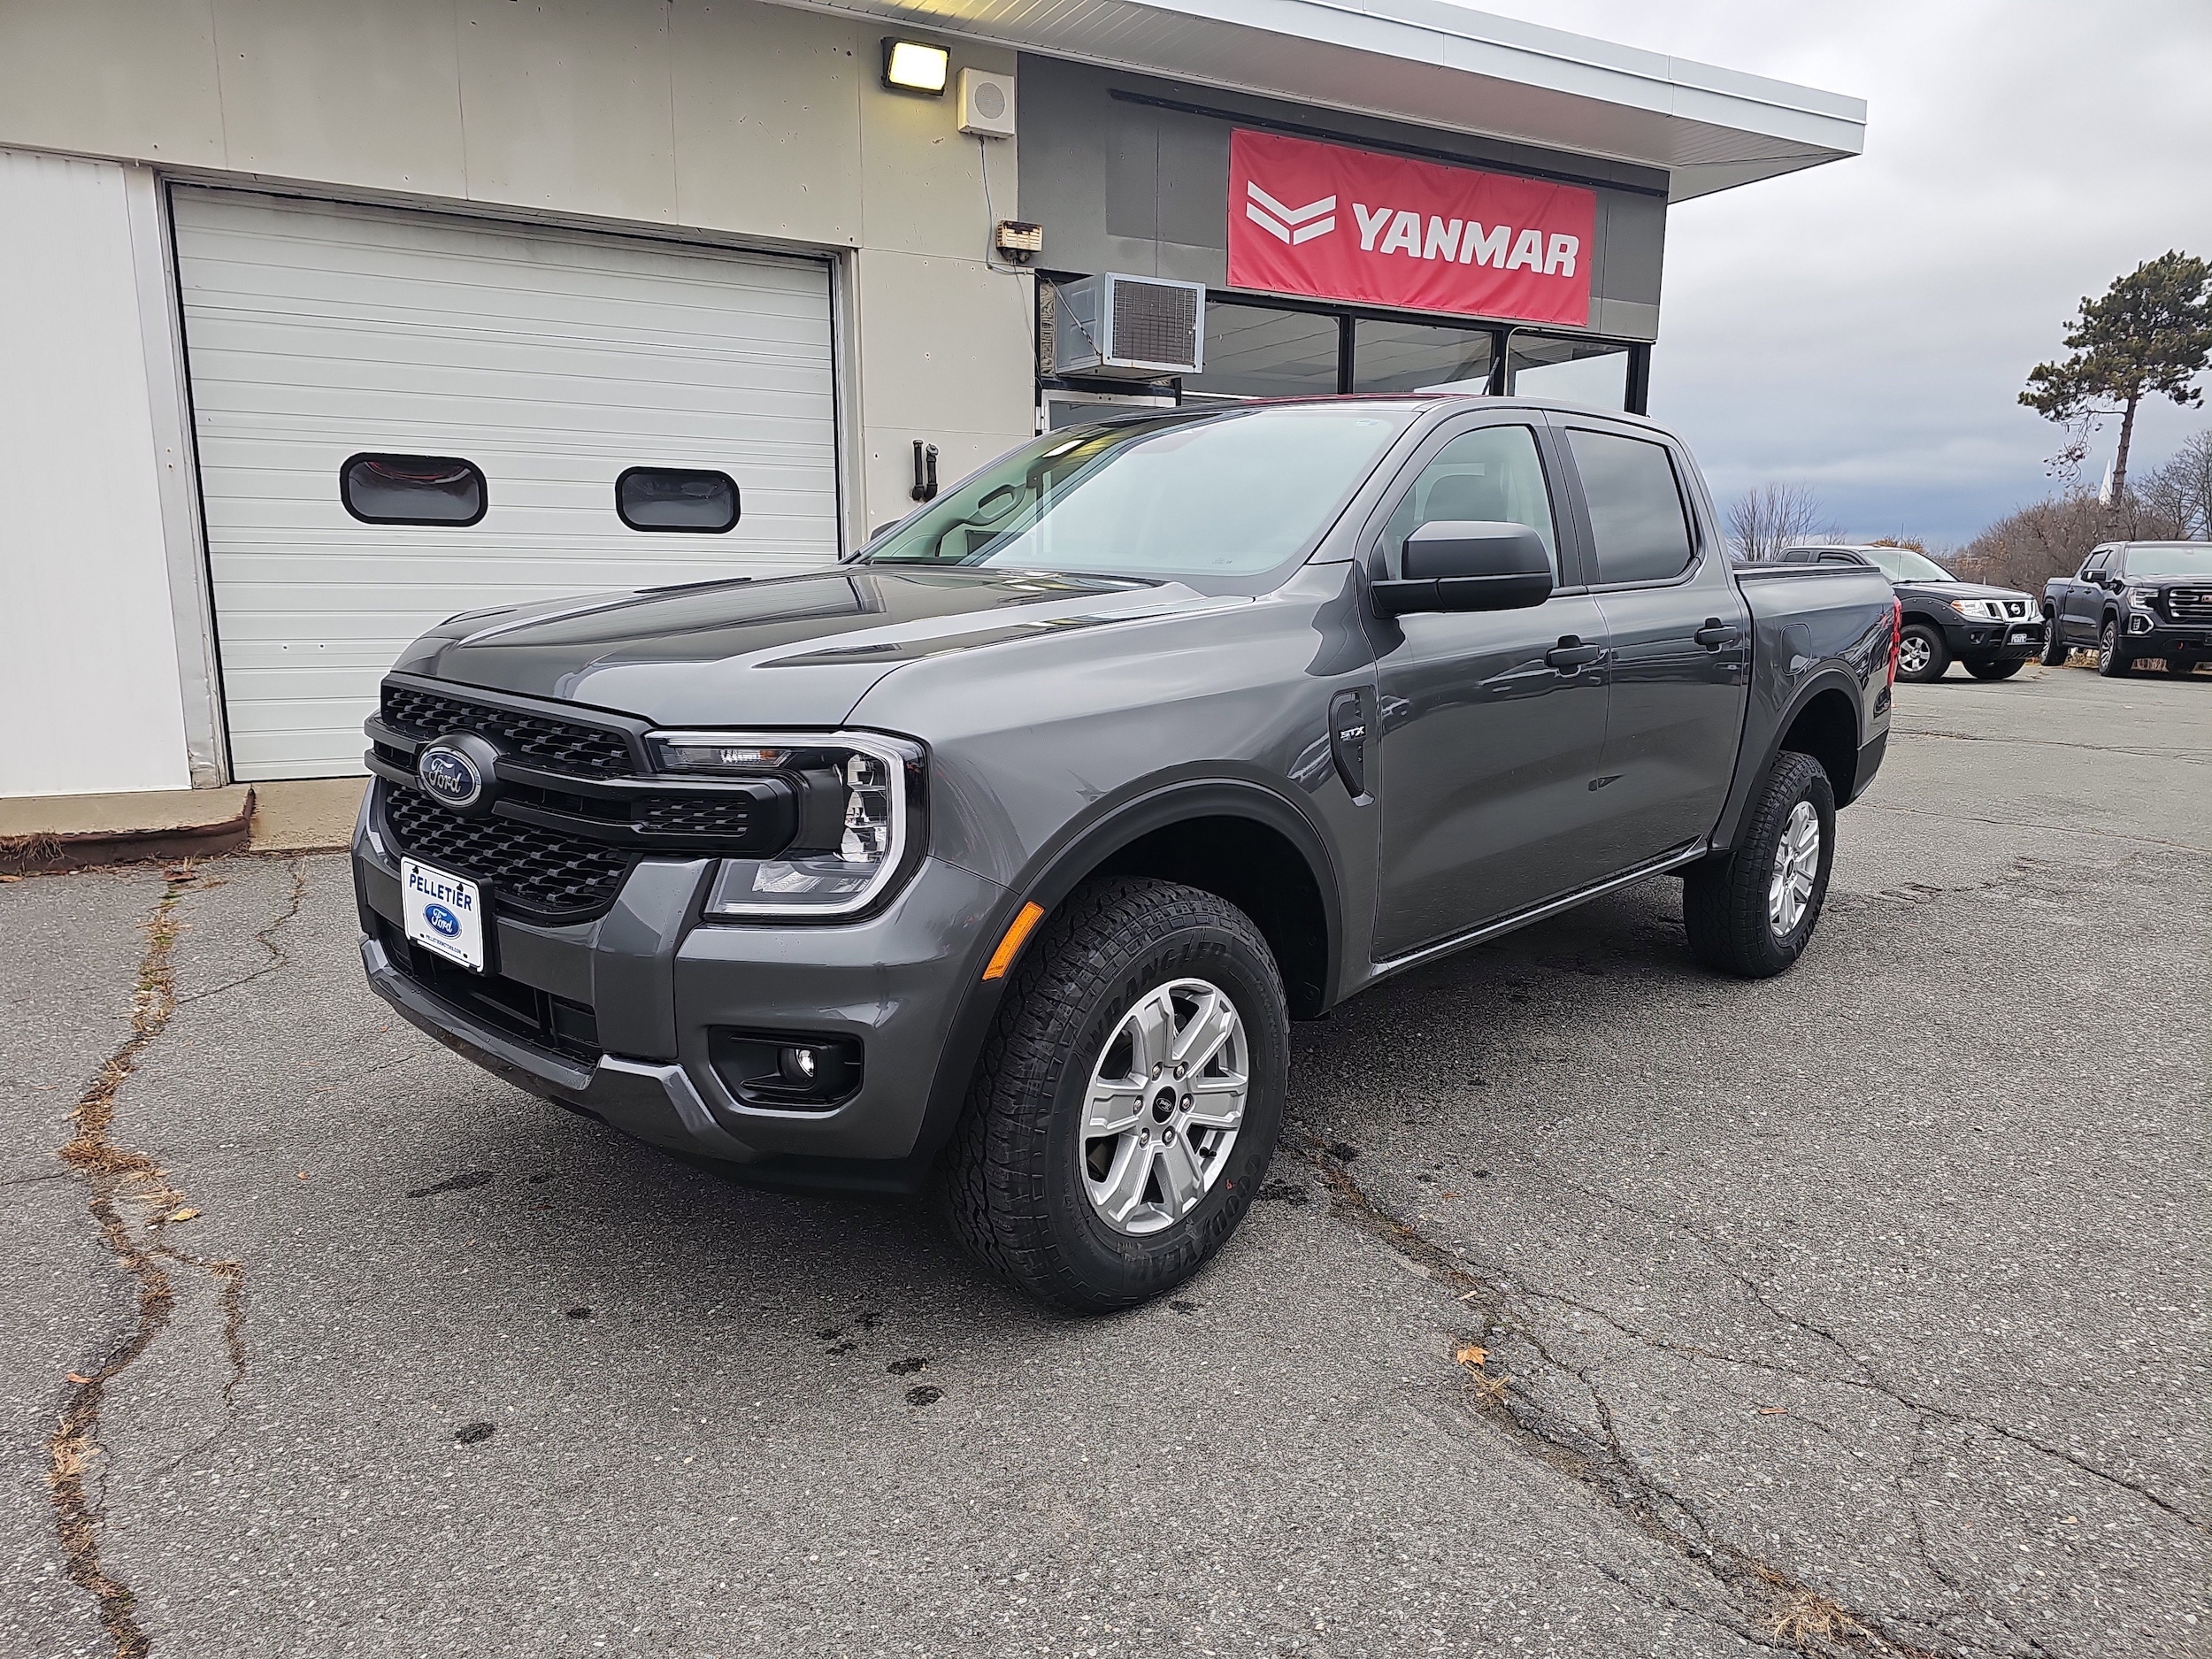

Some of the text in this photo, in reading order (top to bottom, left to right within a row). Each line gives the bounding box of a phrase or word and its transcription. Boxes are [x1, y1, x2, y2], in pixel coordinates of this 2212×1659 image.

[1352, 203, 1579, 277] YANMAR
[1340, 726, 1364, 740] STX
[429, 757, 462, 793] Ford
[409, 873, 472, 911] PELLETIER
[431, 908, 454, 933] Ford
